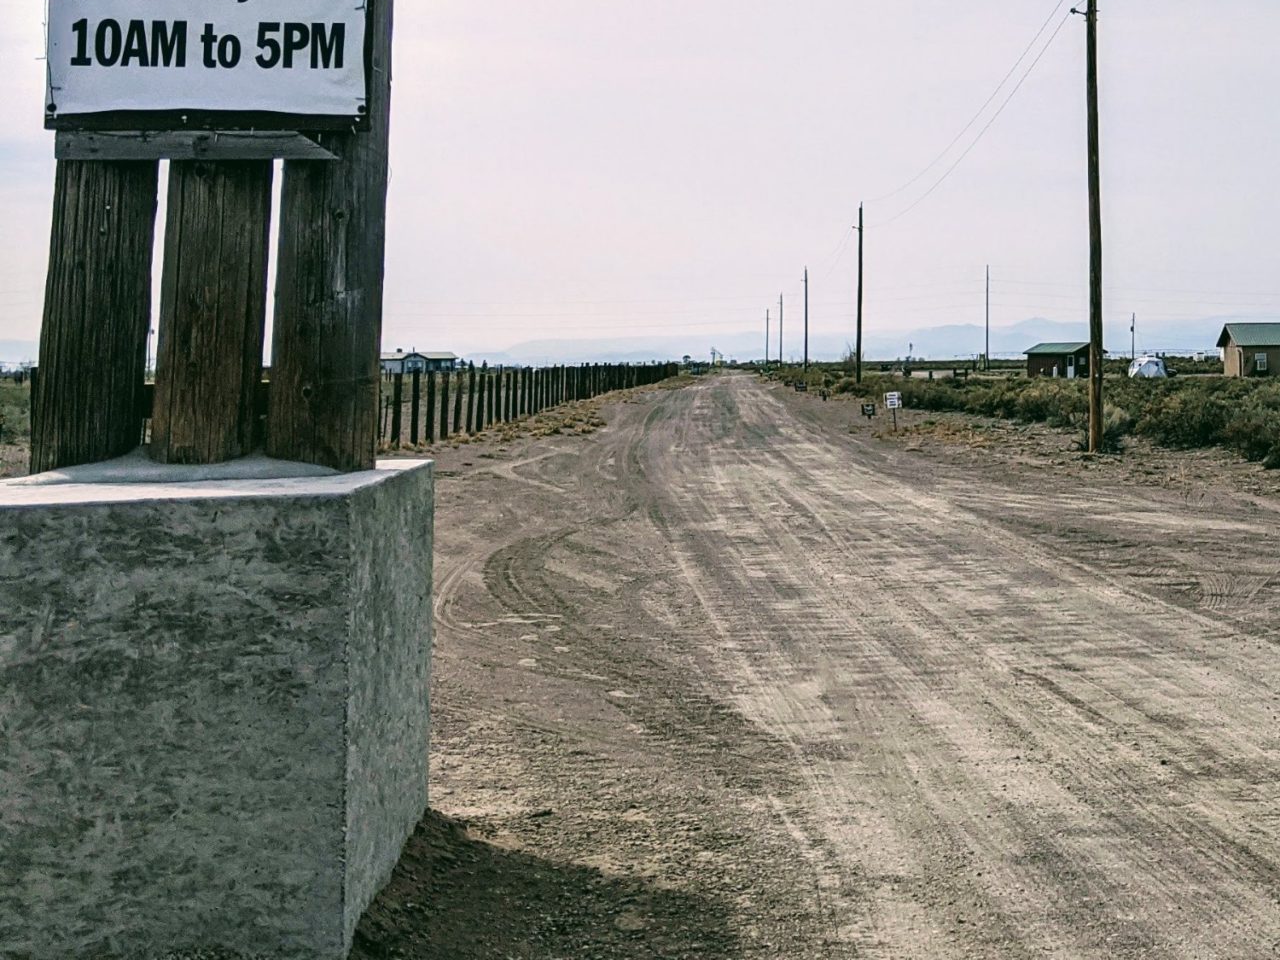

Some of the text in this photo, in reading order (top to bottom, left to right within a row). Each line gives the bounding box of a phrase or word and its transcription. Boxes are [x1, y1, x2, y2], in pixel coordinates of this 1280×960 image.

[70, 17, 346, 70] 10AM to 5PM
